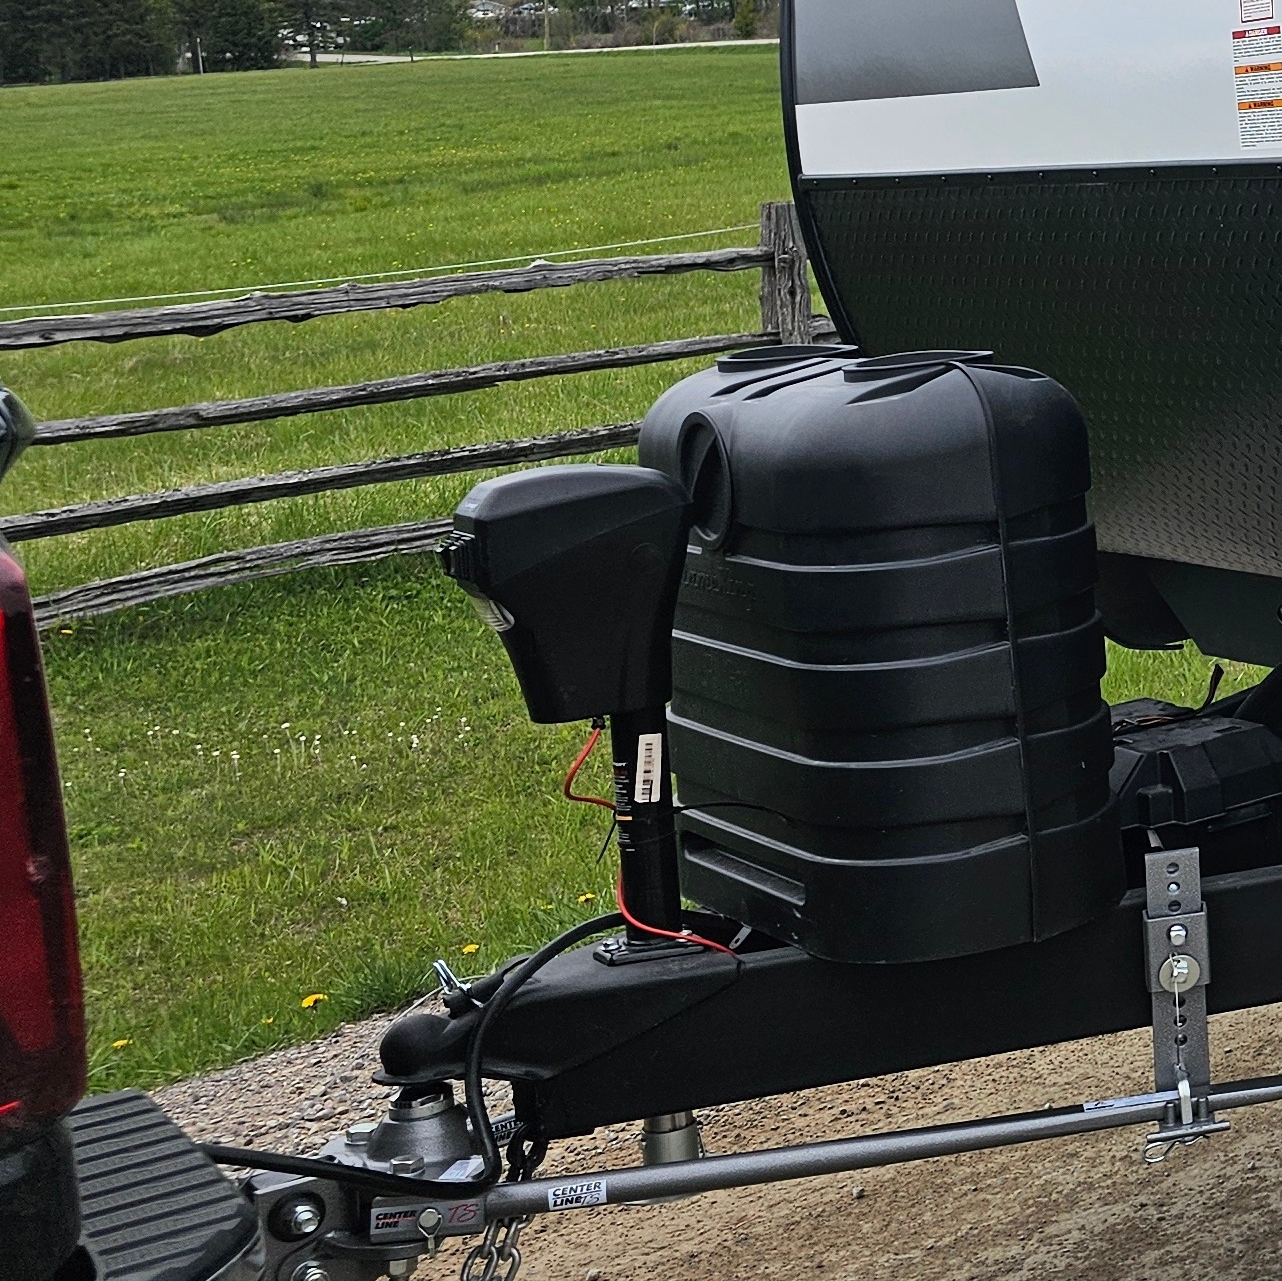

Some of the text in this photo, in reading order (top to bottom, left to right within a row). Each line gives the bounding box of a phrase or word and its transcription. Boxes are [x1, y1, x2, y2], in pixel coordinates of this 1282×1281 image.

[553, 1181, 602, 1197] CENTER
[553, 1196, 582, 1207] LINE
[376, 1209, 417, 1221] CENTER
[375, 1220, 400, 1230] LINE
